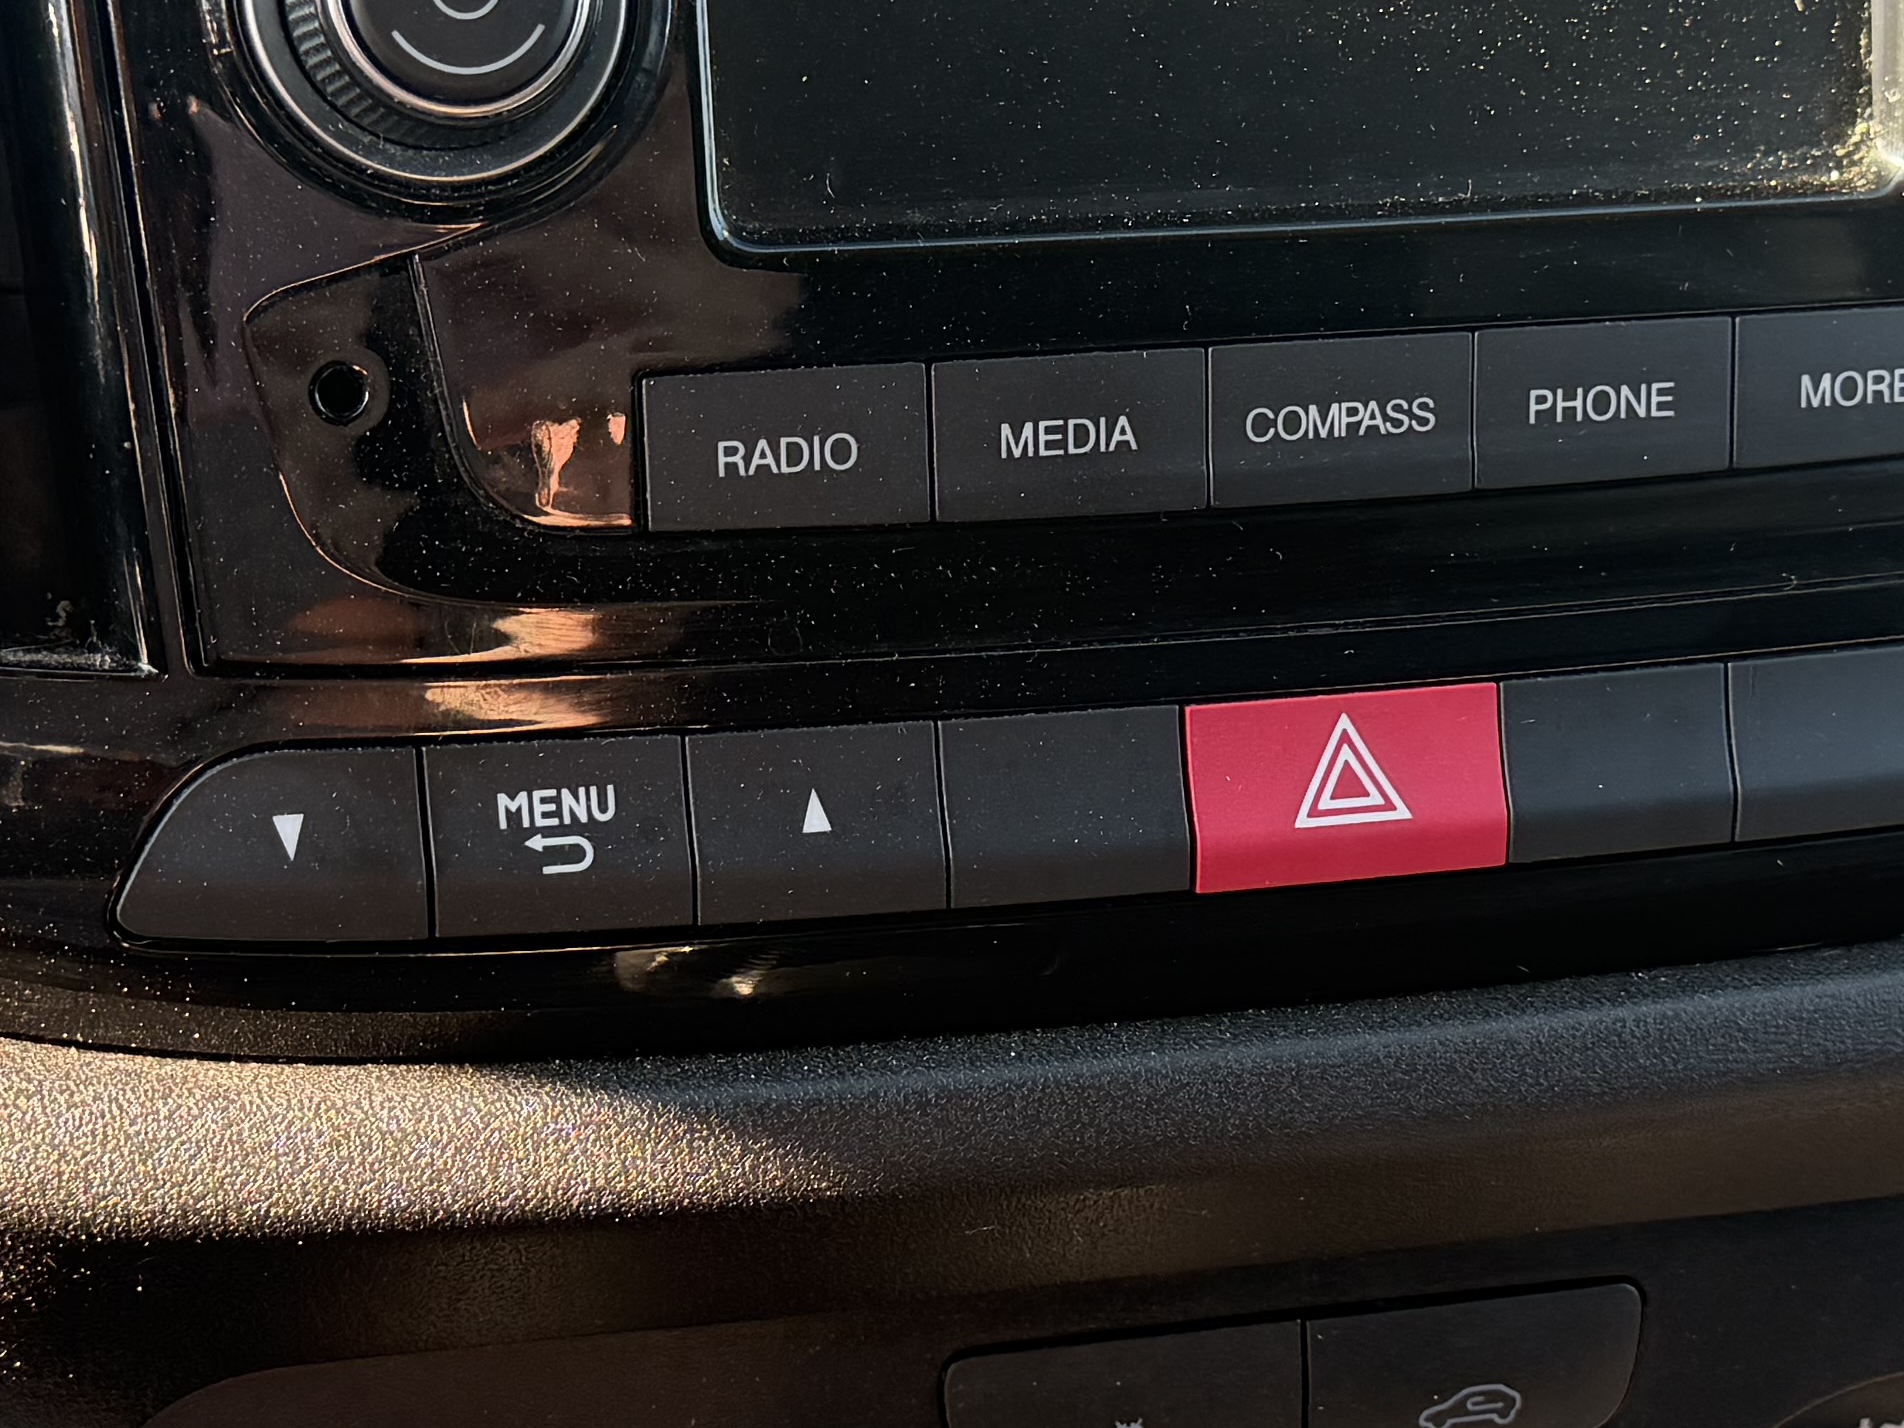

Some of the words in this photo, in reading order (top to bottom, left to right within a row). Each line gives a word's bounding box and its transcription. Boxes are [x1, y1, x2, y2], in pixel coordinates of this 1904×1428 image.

[1243, 395, 1438, 445] COMPASS
[1527, 379, 1677, 426] PHONE
[715, 430, 859, 479] RADIO
[998, 413, 1139, 460] MEDIA
[495, 783, 617, 831] MENU
